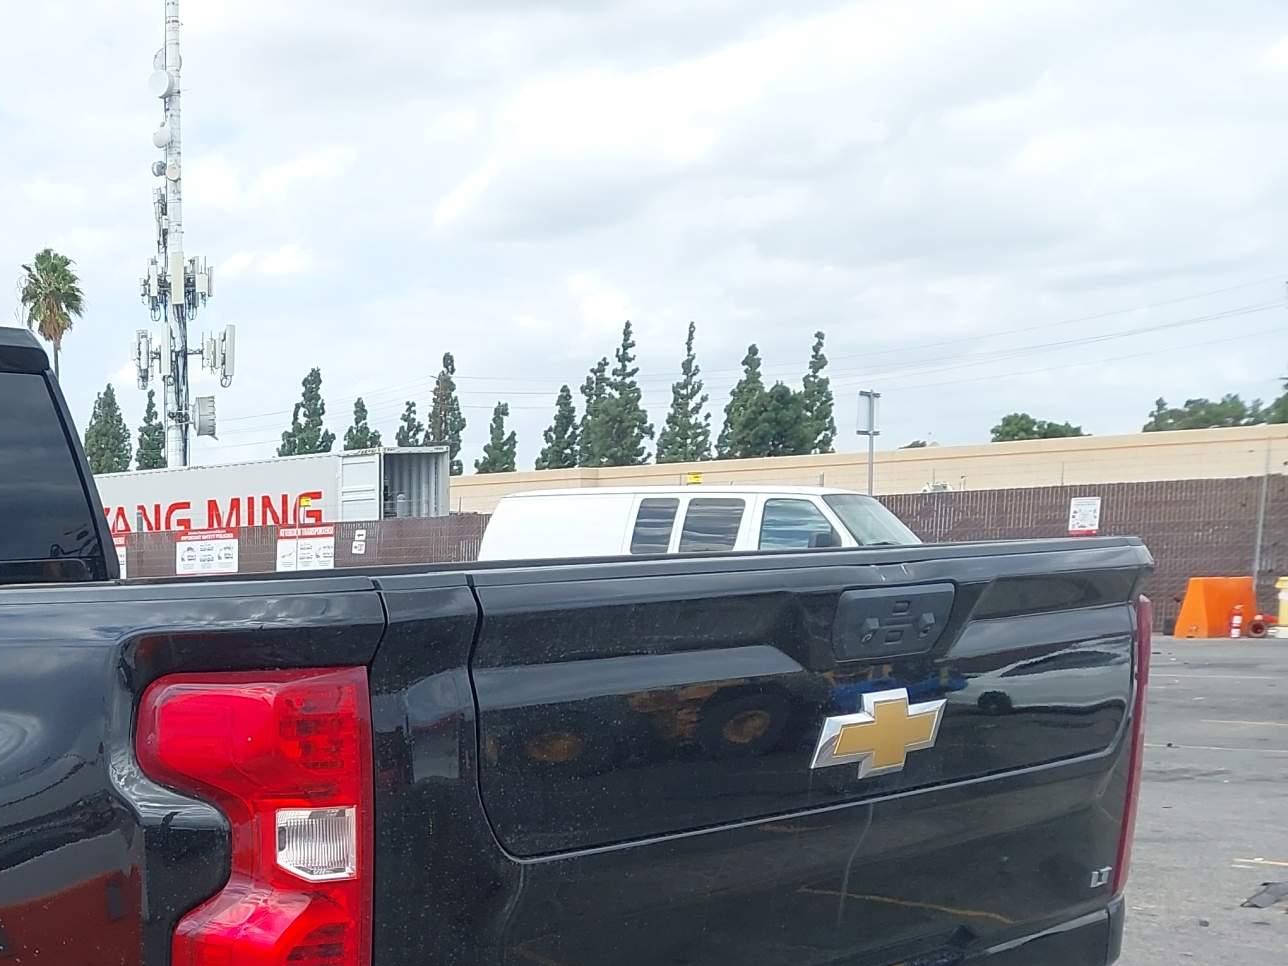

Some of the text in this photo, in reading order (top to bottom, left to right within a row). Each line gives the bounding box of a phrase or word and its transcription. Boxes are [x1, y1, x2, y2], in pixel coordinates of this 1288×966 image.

[103, 490, 323, 533] ANG MING
[1090, 866, 1113, 888] LT
